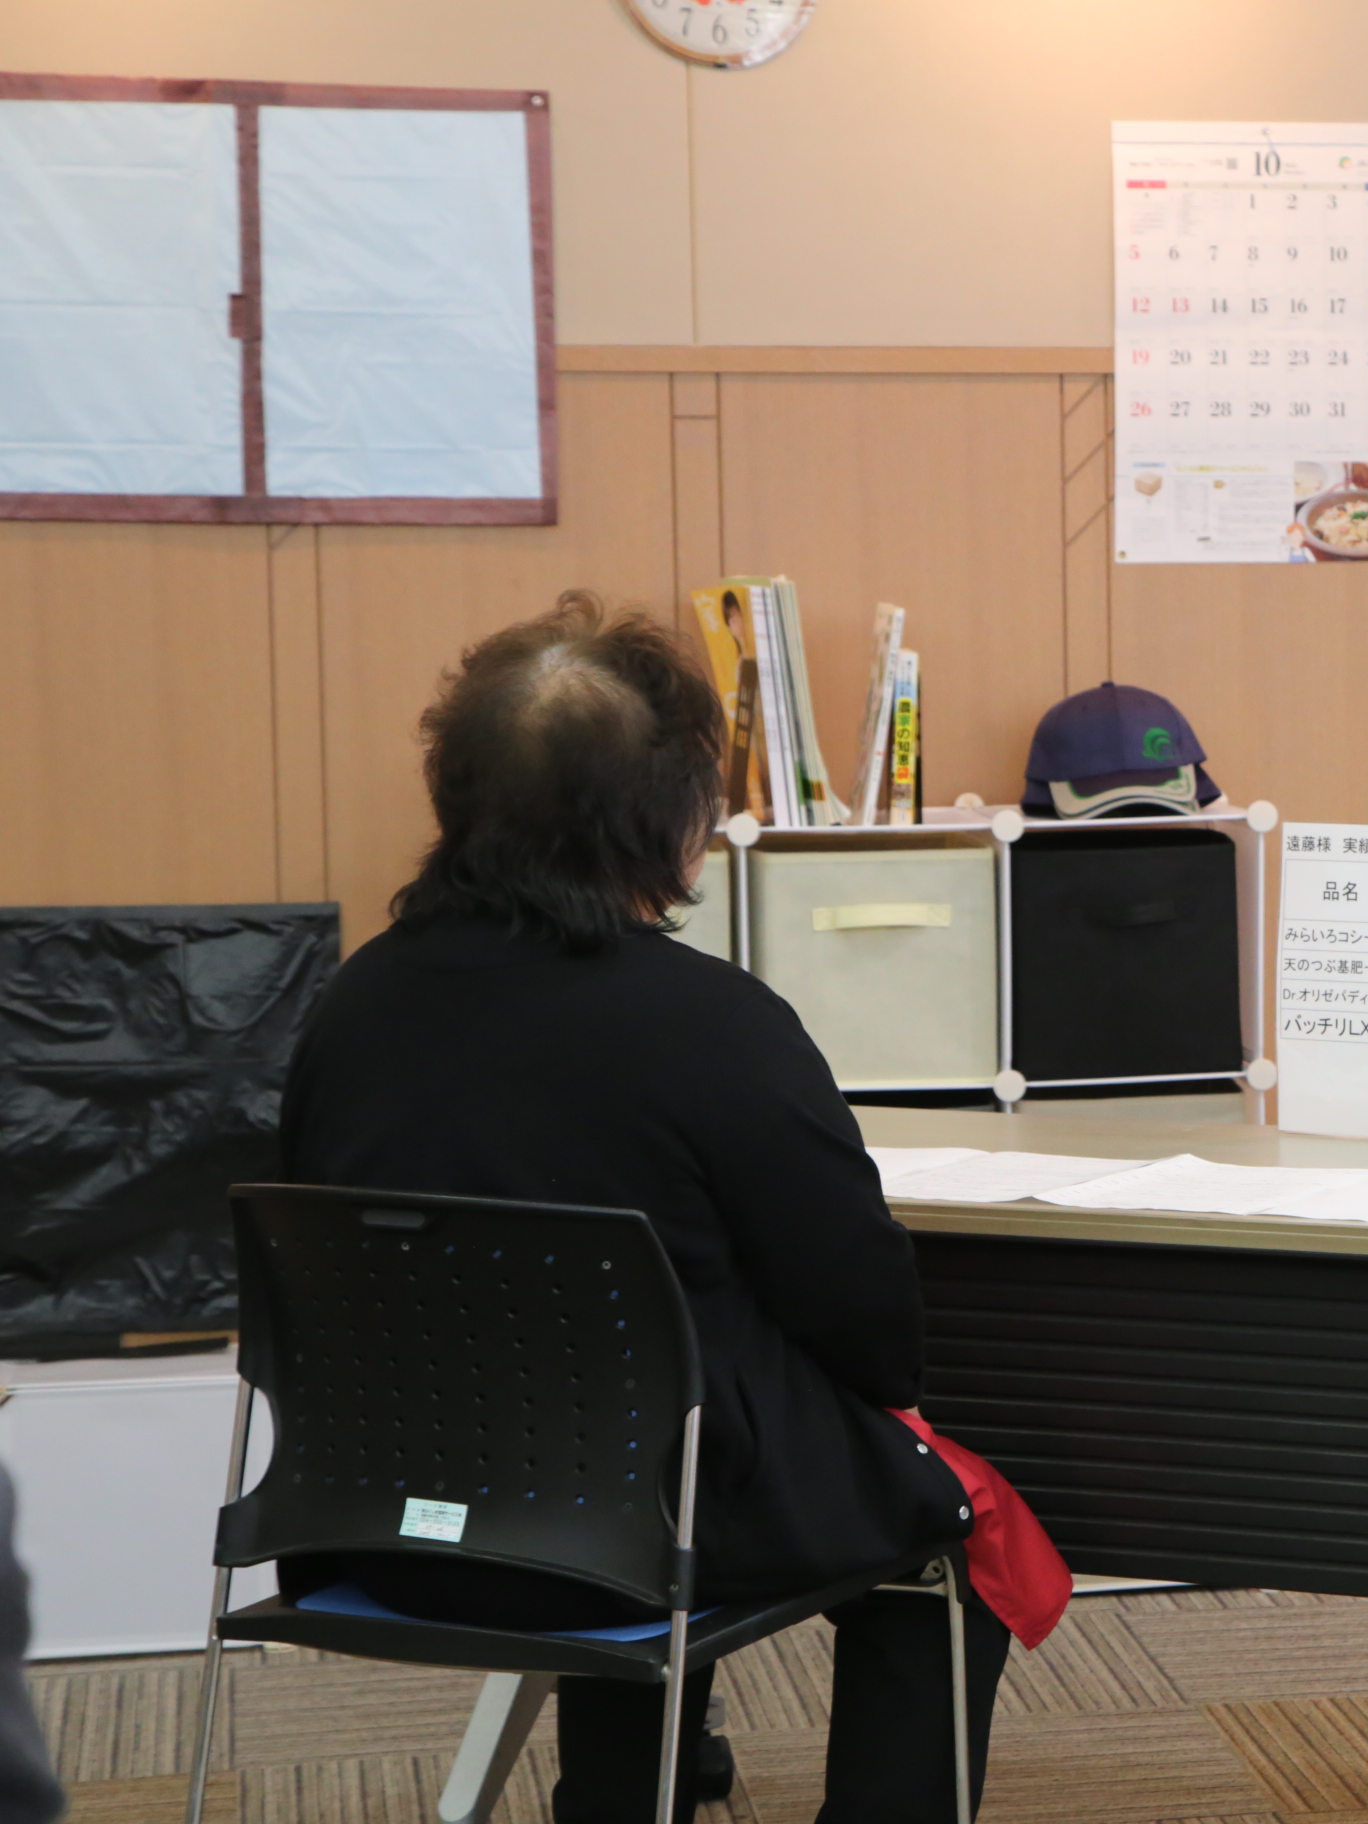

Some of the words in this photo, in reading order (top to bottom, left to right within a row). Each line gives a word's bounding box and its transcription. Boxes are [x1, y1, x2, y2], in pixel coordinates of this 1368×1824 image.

[678, 6, 693, 37] 7
[711, 13, 728, 45] 6
[744, 7, 761, 37] 5
[1253, 151, 1281, 177] 10
[1248, 192, 1257, 210] 1
[1286, 193, 1299, 211] 2
[1326, 193, 1338, 210] 3
[1128, 243, 1141, 261] 5
[1168, 245, 1180, 261] 6
[1207, 244, 1220, 261] 7
[1247, 245, 1260, 262] 8
[1286, 246, 1299, 262] 9
[1328, 245, 1349, 262] 10
[1132, 297, 1151, 314] 12
[1171, 297, 1190, 314] 13
[1210, 298, 1229, 314] 14
[1251, 298, 1268, 314] 15
[1289, 298, 1308, 314] 16
[1329, 298, 1347, 315] 17
[1132, 349, 1150, 365] 19
[1170, 350, 1192, 366] 20
[1210, 350, 1227, 366] 21
[1249, 350, 1270, 366] 22
[1288, 350, 1310, 366] 23
[1328, 350, 1349, 366] 24
[1130, 402, 1152, 418] 26
[1170, 401, 1190, 418] 27
[1210, 401, 1232, 418] 28
[1250, 401, 1271, 418] 29
[1288, 401, 1311, 418] 30
[1328, 401, 1347, 418] 31
[1286, 835, 1332, 853] 遠藤様
[1323, 881, 1358, 901] 品名
